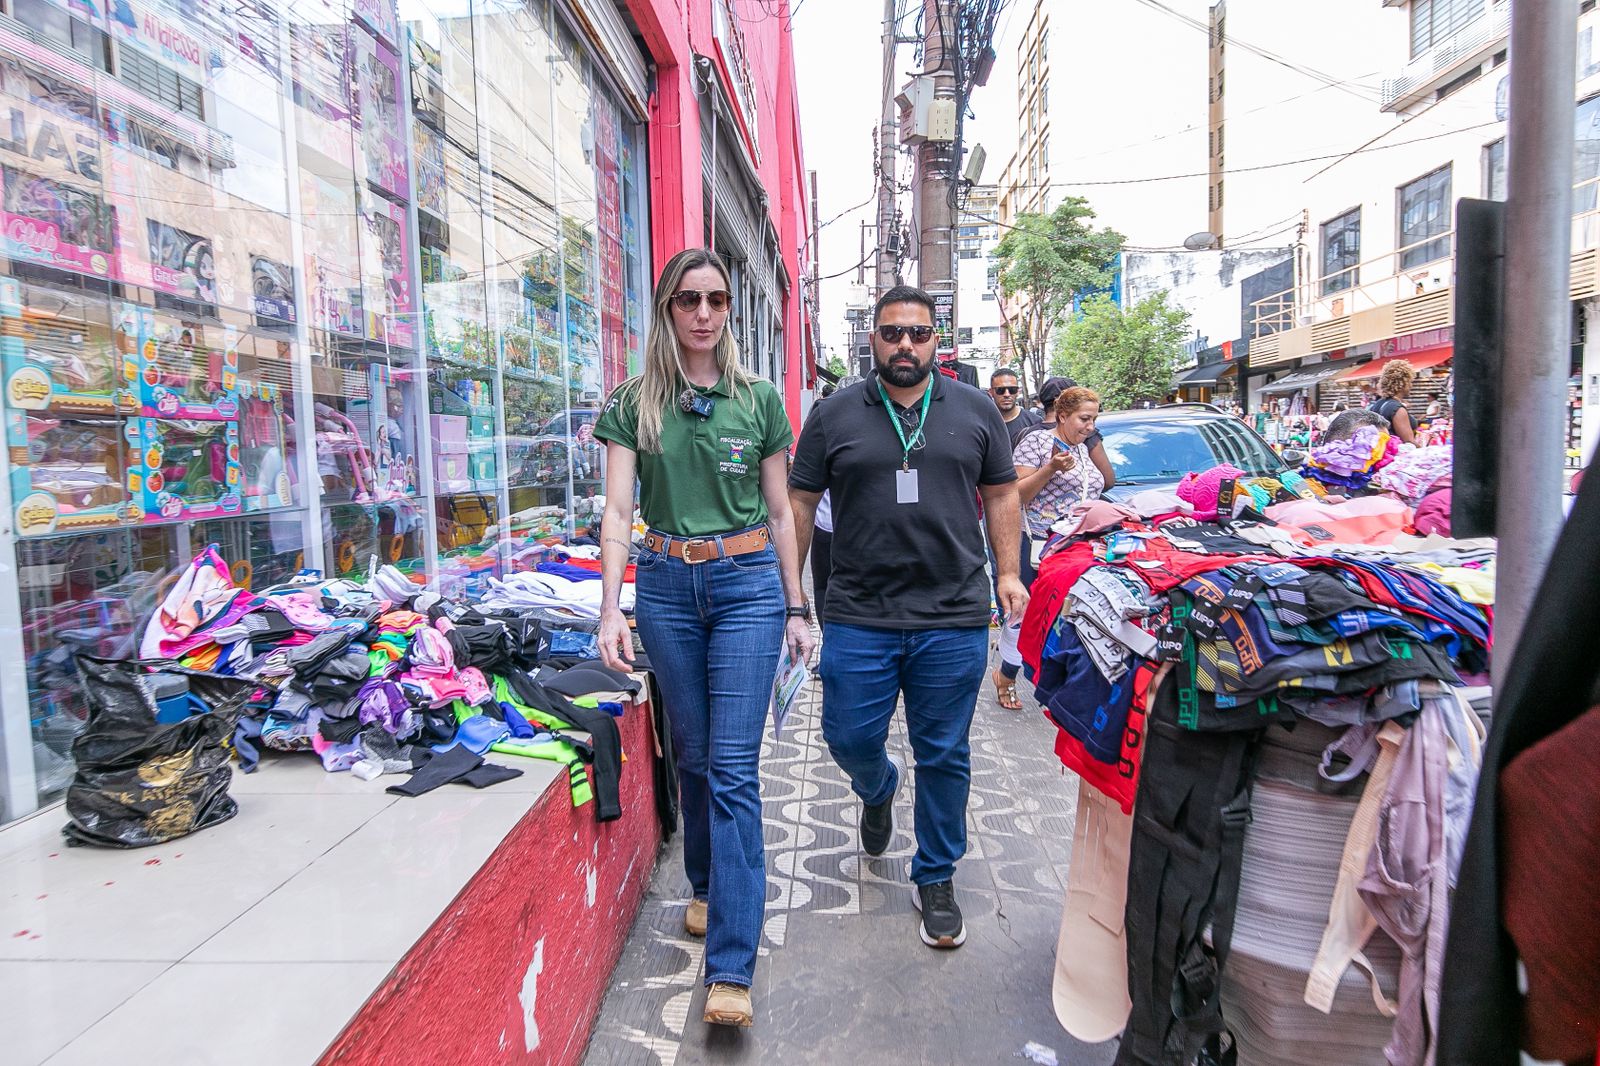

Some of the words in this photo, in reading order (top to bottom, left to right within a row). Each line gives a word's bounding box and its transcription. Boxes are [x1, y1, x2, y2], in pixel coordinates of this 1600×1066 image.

[719, 461, 749, 470] PREFEITURA
[1228, 586, 1254, 600] LUPO
[1190, 607, 1216, 629] LUPO
[1157, 638, 1183, 652] LUPO
[1234, 636, 1256, 677] UPO
